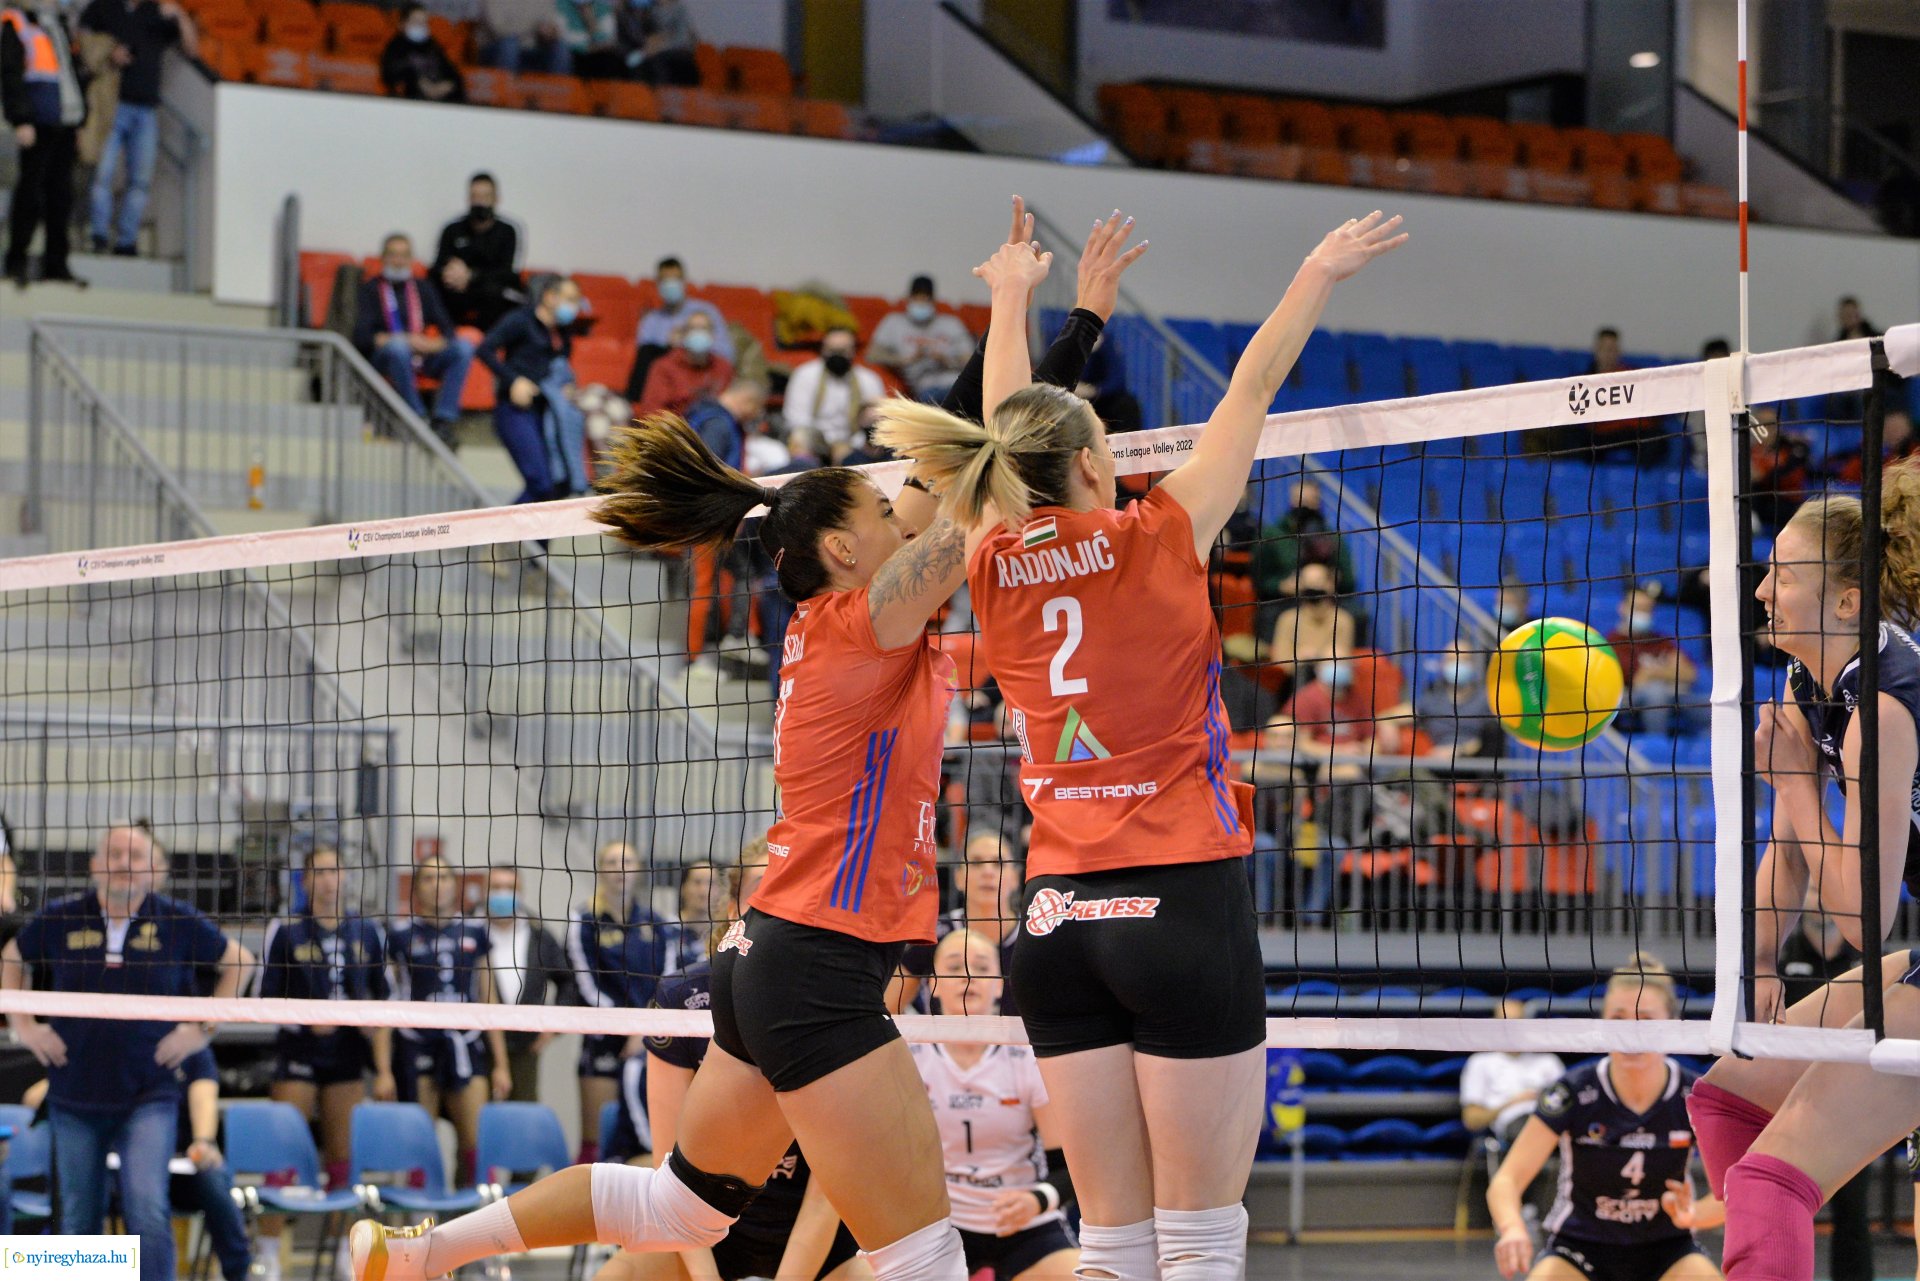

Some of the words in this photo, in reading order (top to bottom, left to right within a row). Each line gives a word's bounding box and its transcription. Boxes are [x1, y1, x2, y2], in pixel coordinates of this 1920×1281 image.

[1595, 384, 1635, 407] CEV
[1125, 447, 1151, 459] League
[1152, 442, 1175, 455] Volley
[1175, 439, 1193, 452] 2022
[374, 530, 402, 542] Champions
[402, 527, 420, 540] League
[420, 525, 437, 538] Volley
[437, 524, 450, 534] 2022
[995, 529, 1115, 588] RADONJIĆ
[1041, 595, 1089, 697] 2
[1054, 781, 1158, 800] BESTRONG
[962, 1120, 973, 1154] 1
[1620, 1150, 1645, 1186] 4
